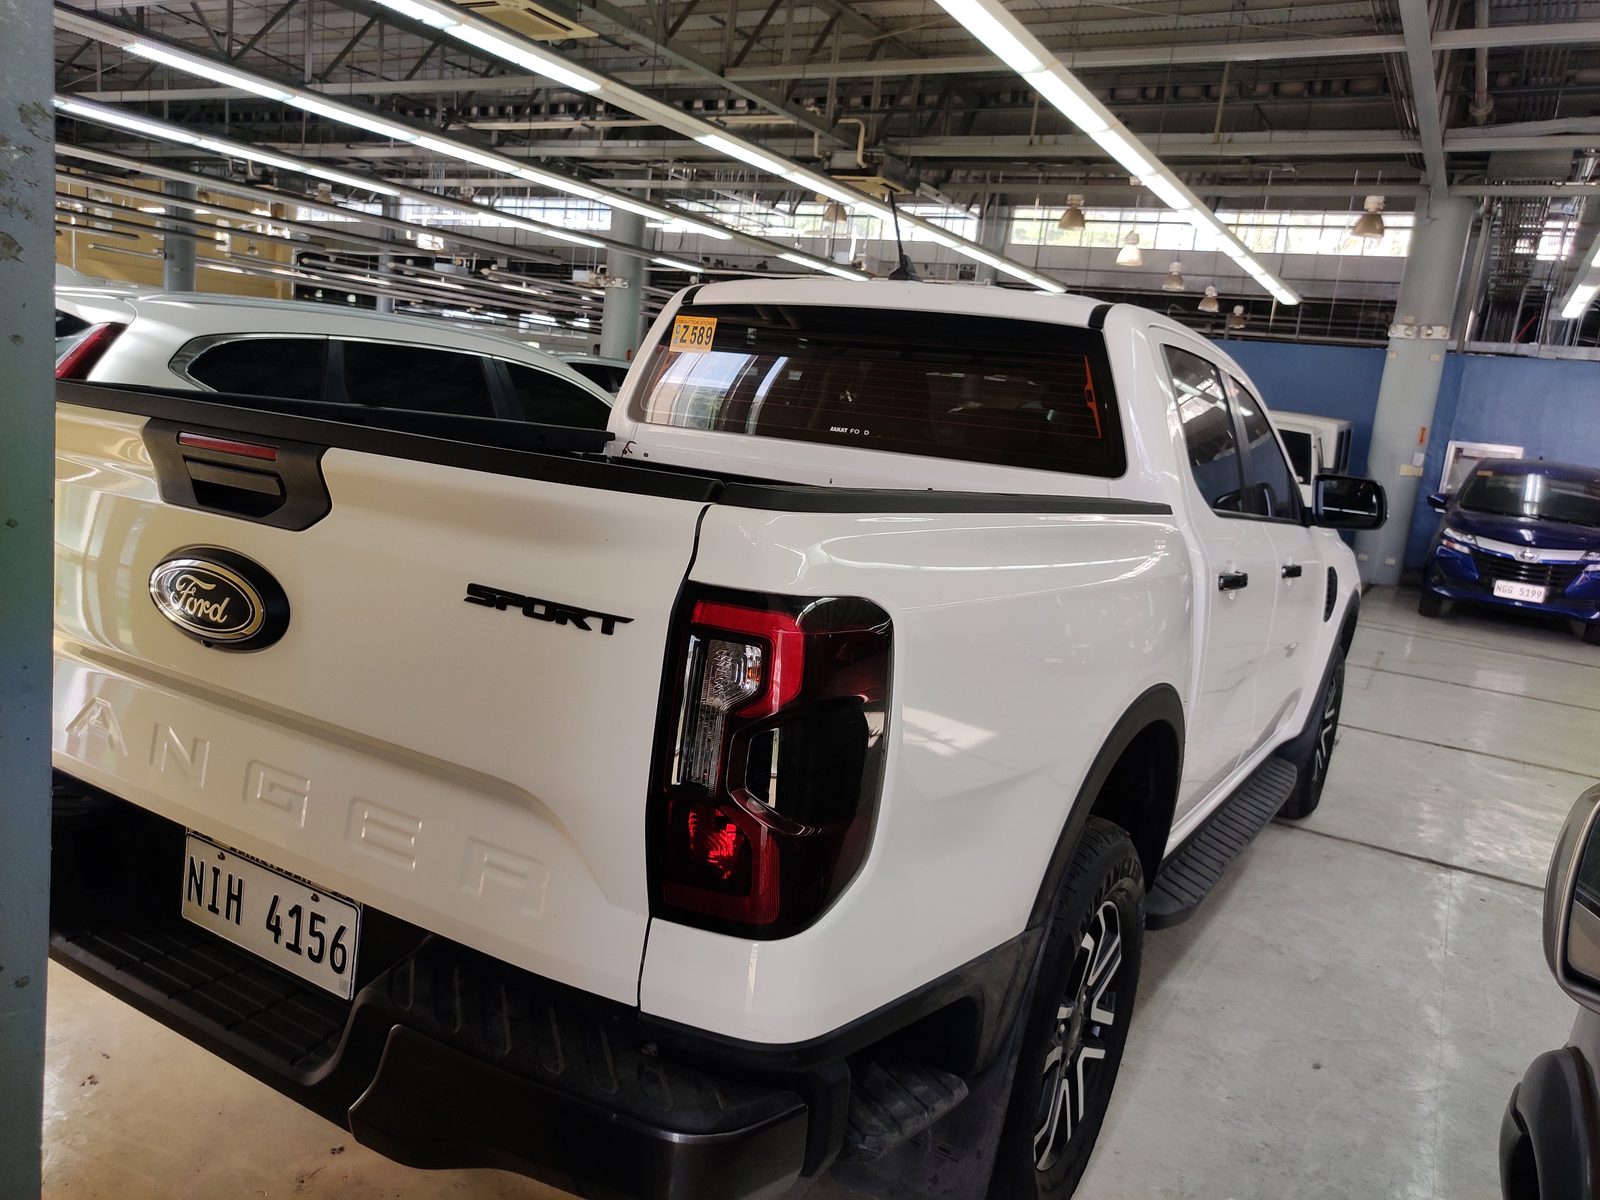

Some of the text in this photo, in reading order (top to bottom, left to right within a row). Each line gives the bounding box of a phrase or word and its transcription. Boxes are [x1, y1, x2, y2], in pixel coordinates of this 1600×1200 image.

[170, 574, 230, 623] Ford
[463, 582, 635, 636] SPORT
[1496, 583, 1542, 598] NGG 5199
[186, 855, 245, 926] NIH
[265, 894, 349, 975] 4156
